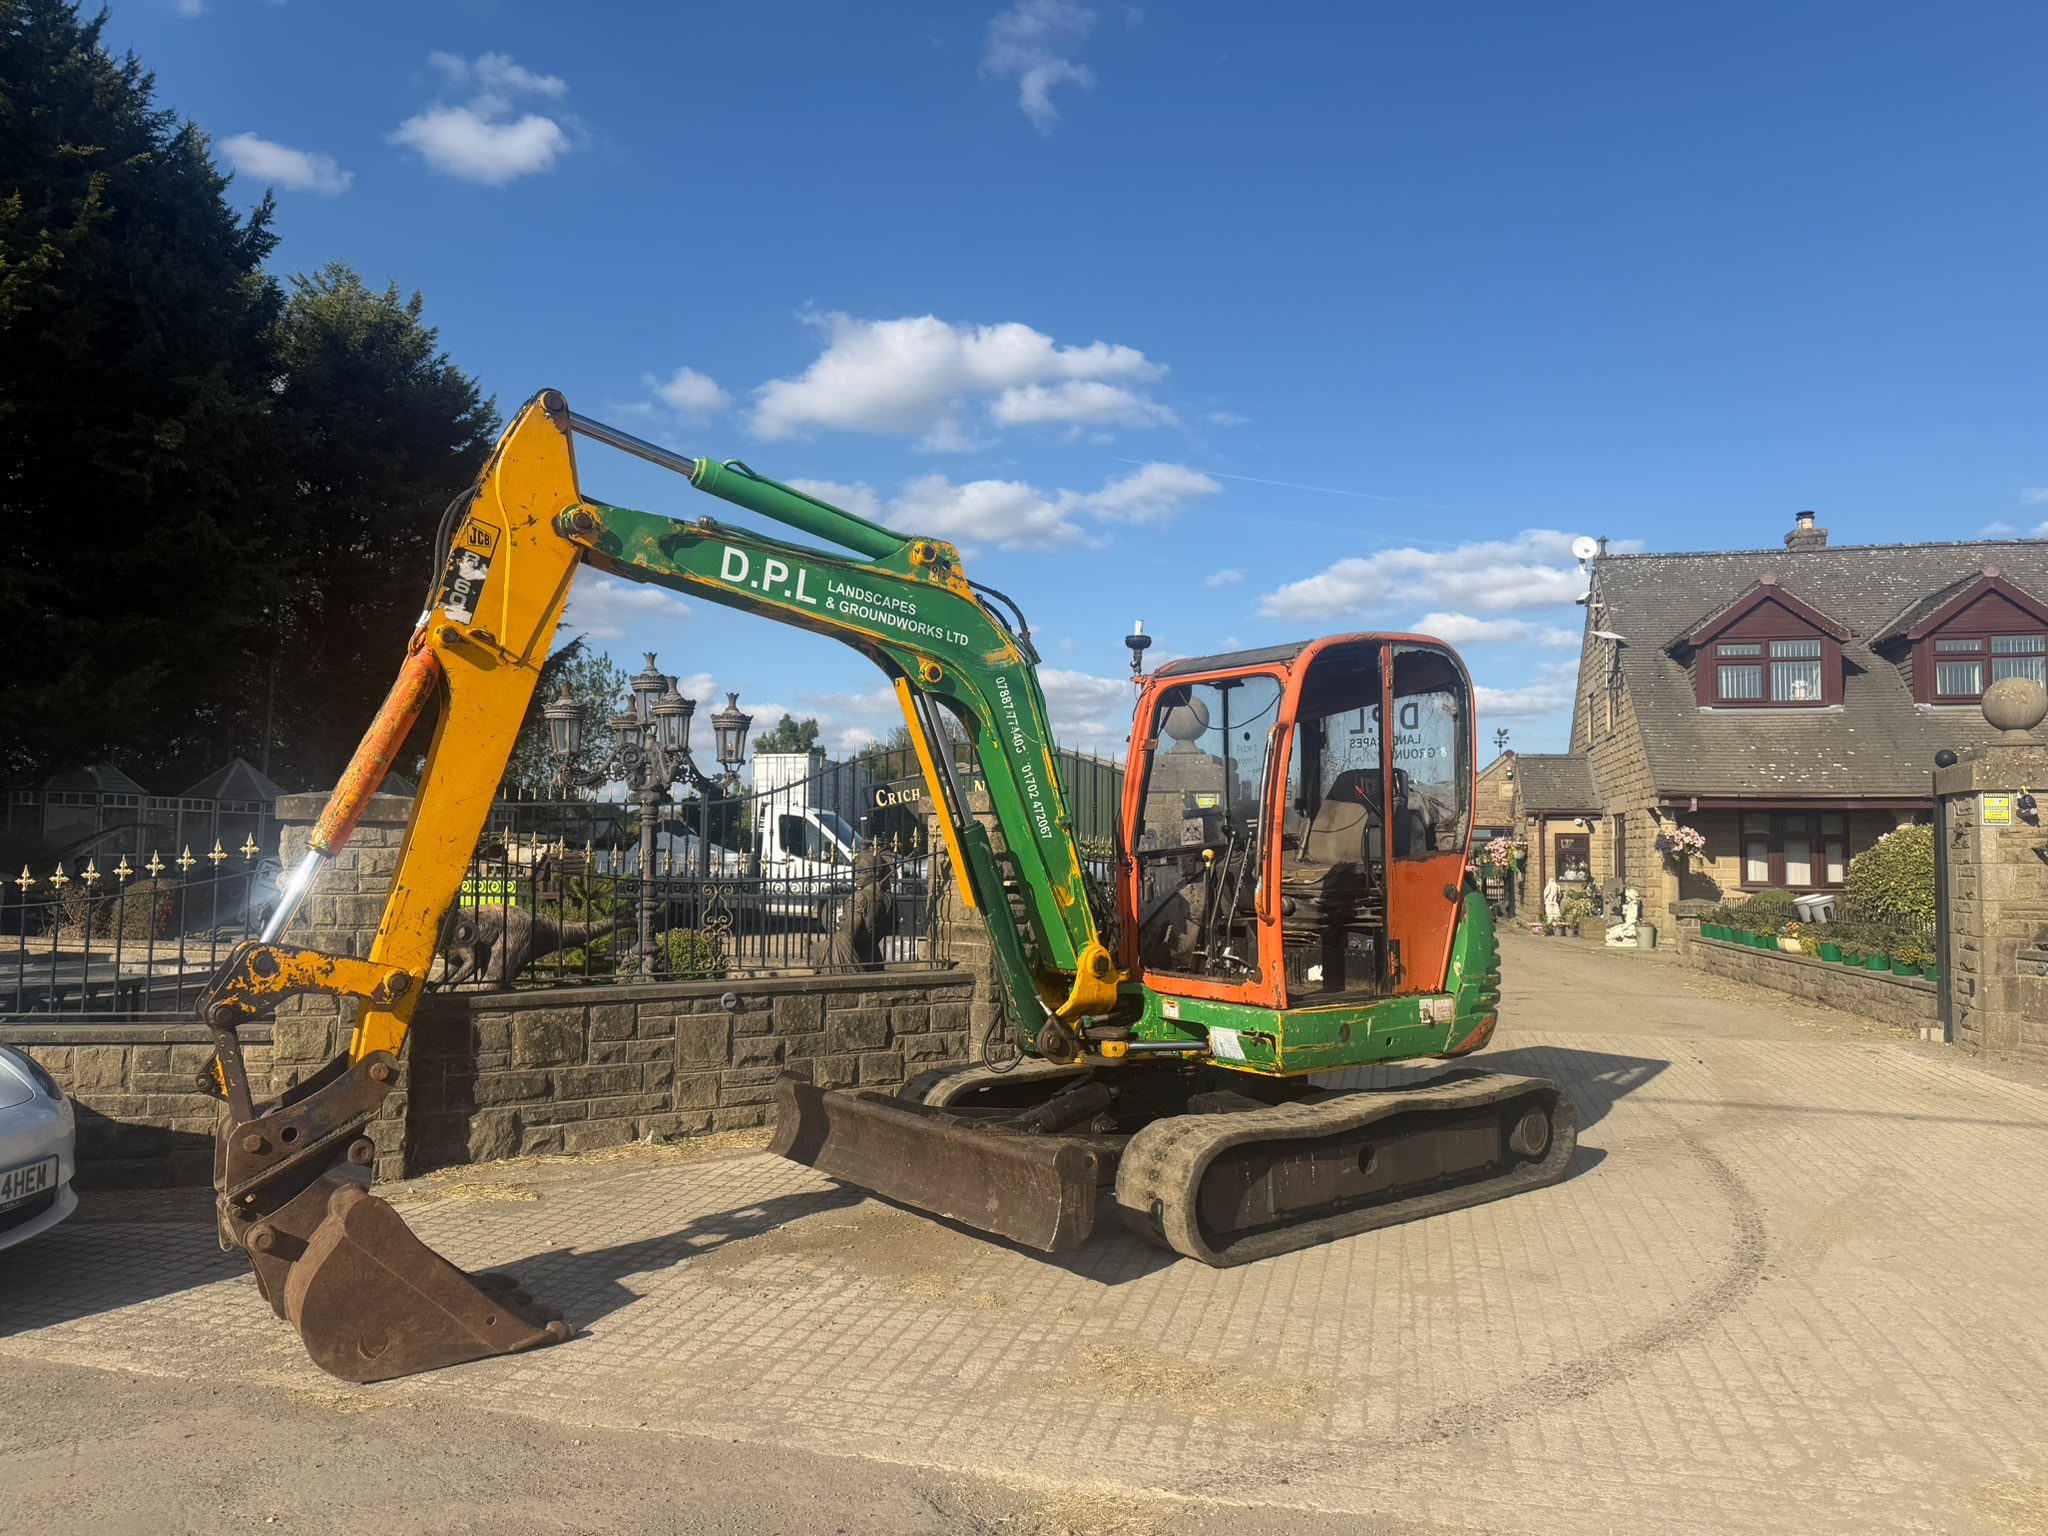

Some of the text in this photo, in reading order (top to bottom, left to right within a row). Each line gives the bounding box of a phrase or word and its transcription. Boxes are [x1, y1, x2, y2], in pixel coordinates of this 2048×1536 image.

[469, 526, 491, 546] JCB
[720, 546, 817, 605] D.P.L
[828, 580, 917, 616] LANDSCAPES
[825, 597, 969, 647] & GROUNDWORKS LTD
[995, 676, 1014, 709] 07887
[1021, 764, 1039, 799] 01702
[1032, 801, 1052, 839] 472067
